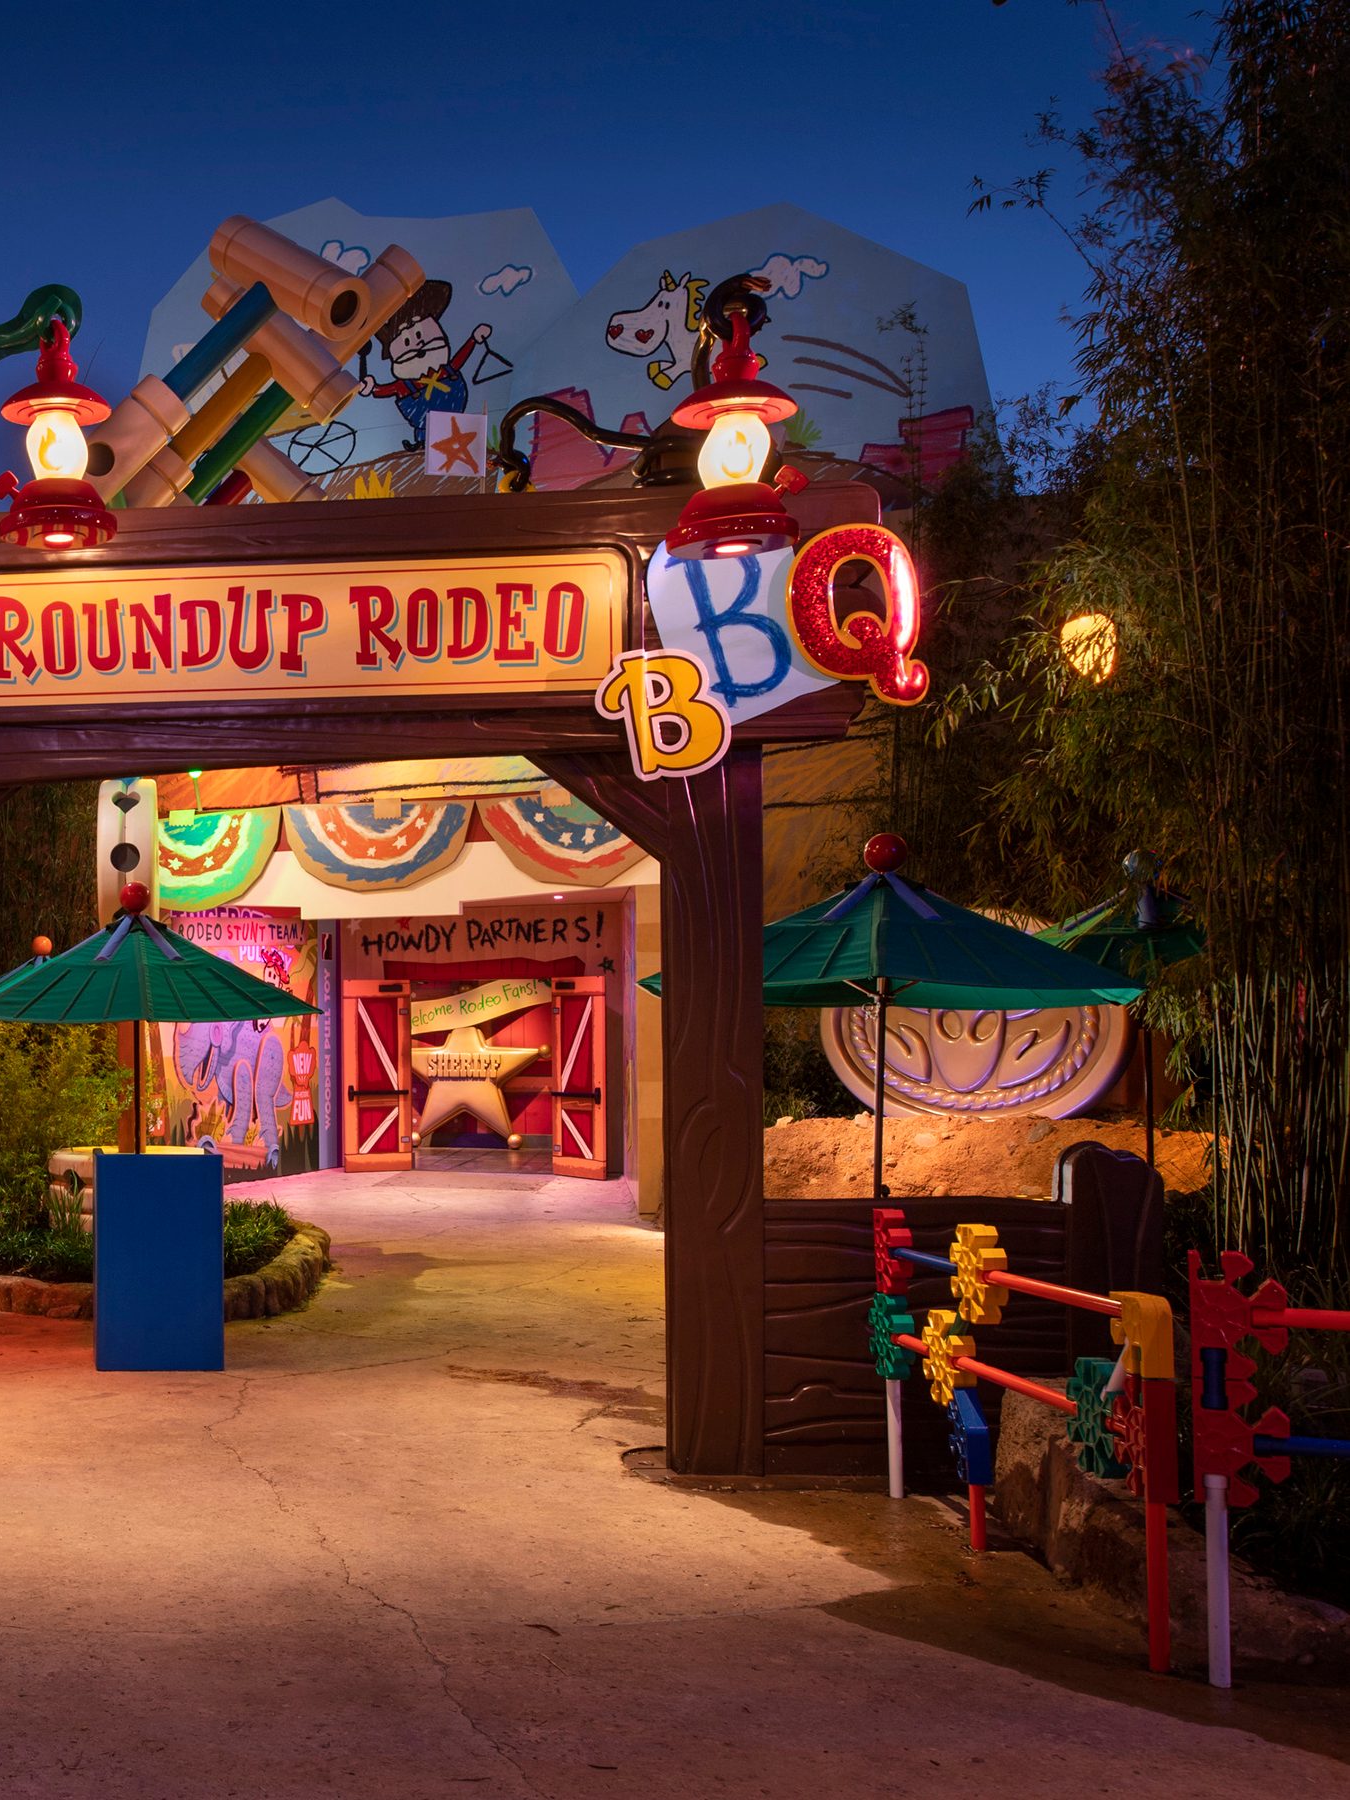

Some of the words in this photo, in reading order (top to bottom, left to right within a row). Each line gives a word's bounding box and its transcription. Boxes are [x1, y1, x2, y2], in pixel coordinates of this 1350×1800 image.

[349, 581, 590, 672] RODEO
[178, 922, 222, 942] RODEO
[227, 920, 265, 943] STUNT
[269, 921, 305, 942] TEAM!
[361, 922, 456, 956] HOWDY
[466, 911, 605, 950] PARTNERS!
[323, 967, 331, 1003] TOY
[411, 1004, 454, 1027] elcome
[459, 994, 502, 1015] Rodeo
[502, 979, 538, 1001] Fans!
[323, 1007, 332, 1050] PULL
[292, 1053, 312, 1074] NEW
[427, 1053, 501, 1077] SHERIFF
[292, 1099, 312, 1122] FUN
[324, 1054, 332, 1130] WOODEN
